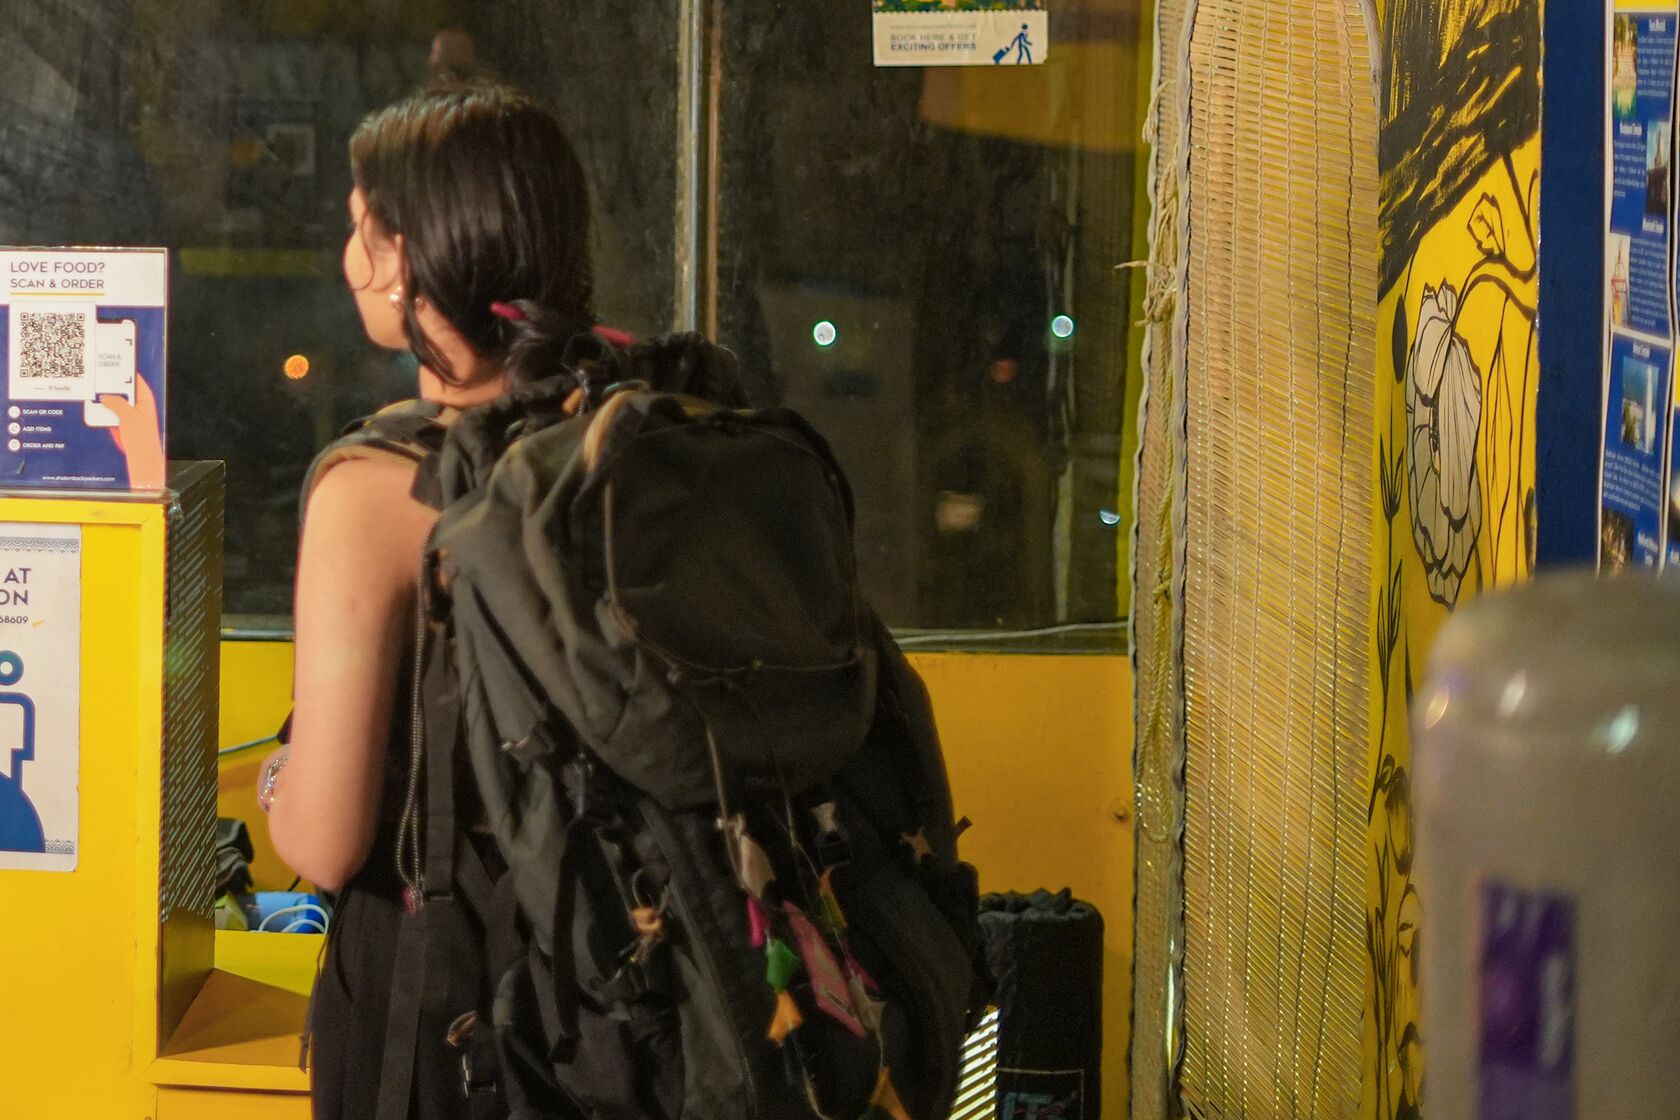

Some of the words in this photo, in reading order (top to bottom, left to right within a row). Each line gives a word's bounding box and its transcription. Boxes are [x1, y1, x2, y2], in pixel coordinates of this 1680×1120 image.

[891, 43, 935, 51] EXCITING
[10, 261, 48, 273] LOVE
[54, 262, 105, 273] FOOD?
[10, 278, 45, 288] SCAN
[49, 279, 56, 288] &
[61, 279, 104, 288] ORDER
[4, 567, 31, 584] AT
